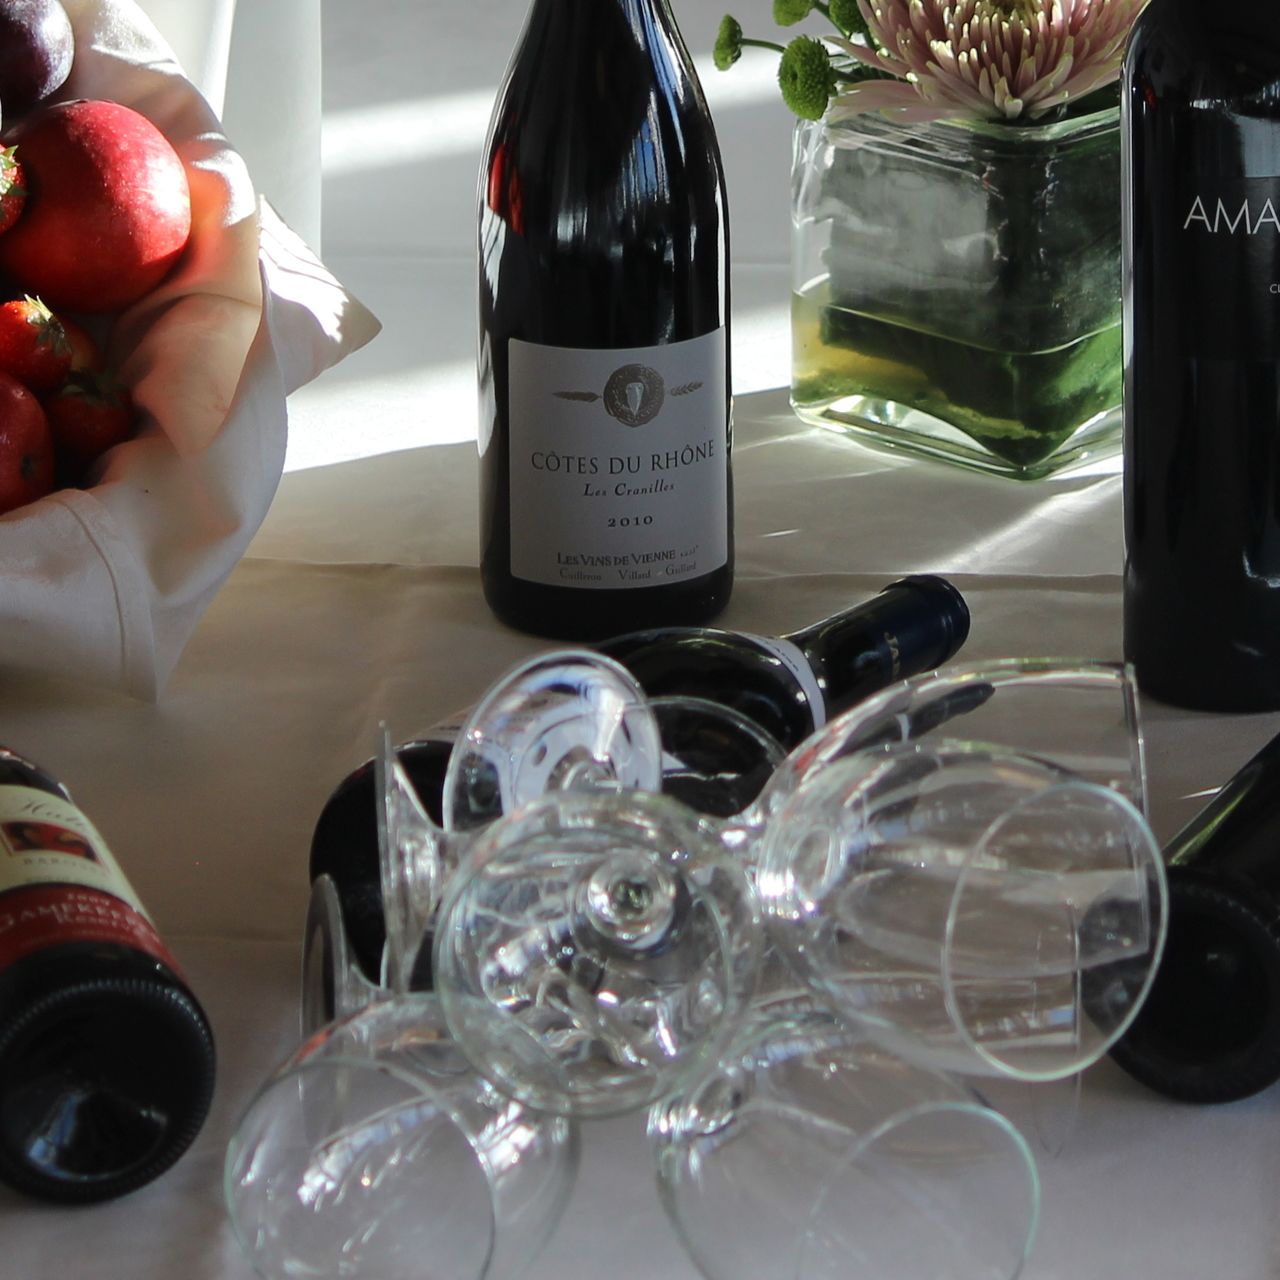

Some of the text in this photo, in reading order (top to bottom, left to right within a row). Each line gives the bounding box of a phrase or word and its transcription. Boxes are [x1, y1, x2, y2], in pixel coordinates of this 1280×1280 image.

[531, 439, 715, 476] CÔTES DU RHÔNE
[583, 479, 675, 497] Les Cranilles
[607, 515, 654, 528] 2010
[557, 551, 579, 566] LES
[579, 553, 612, 567] VINS
[613, 555, 629, 567] DE
[631, 549, 677, 566] VIENNE
